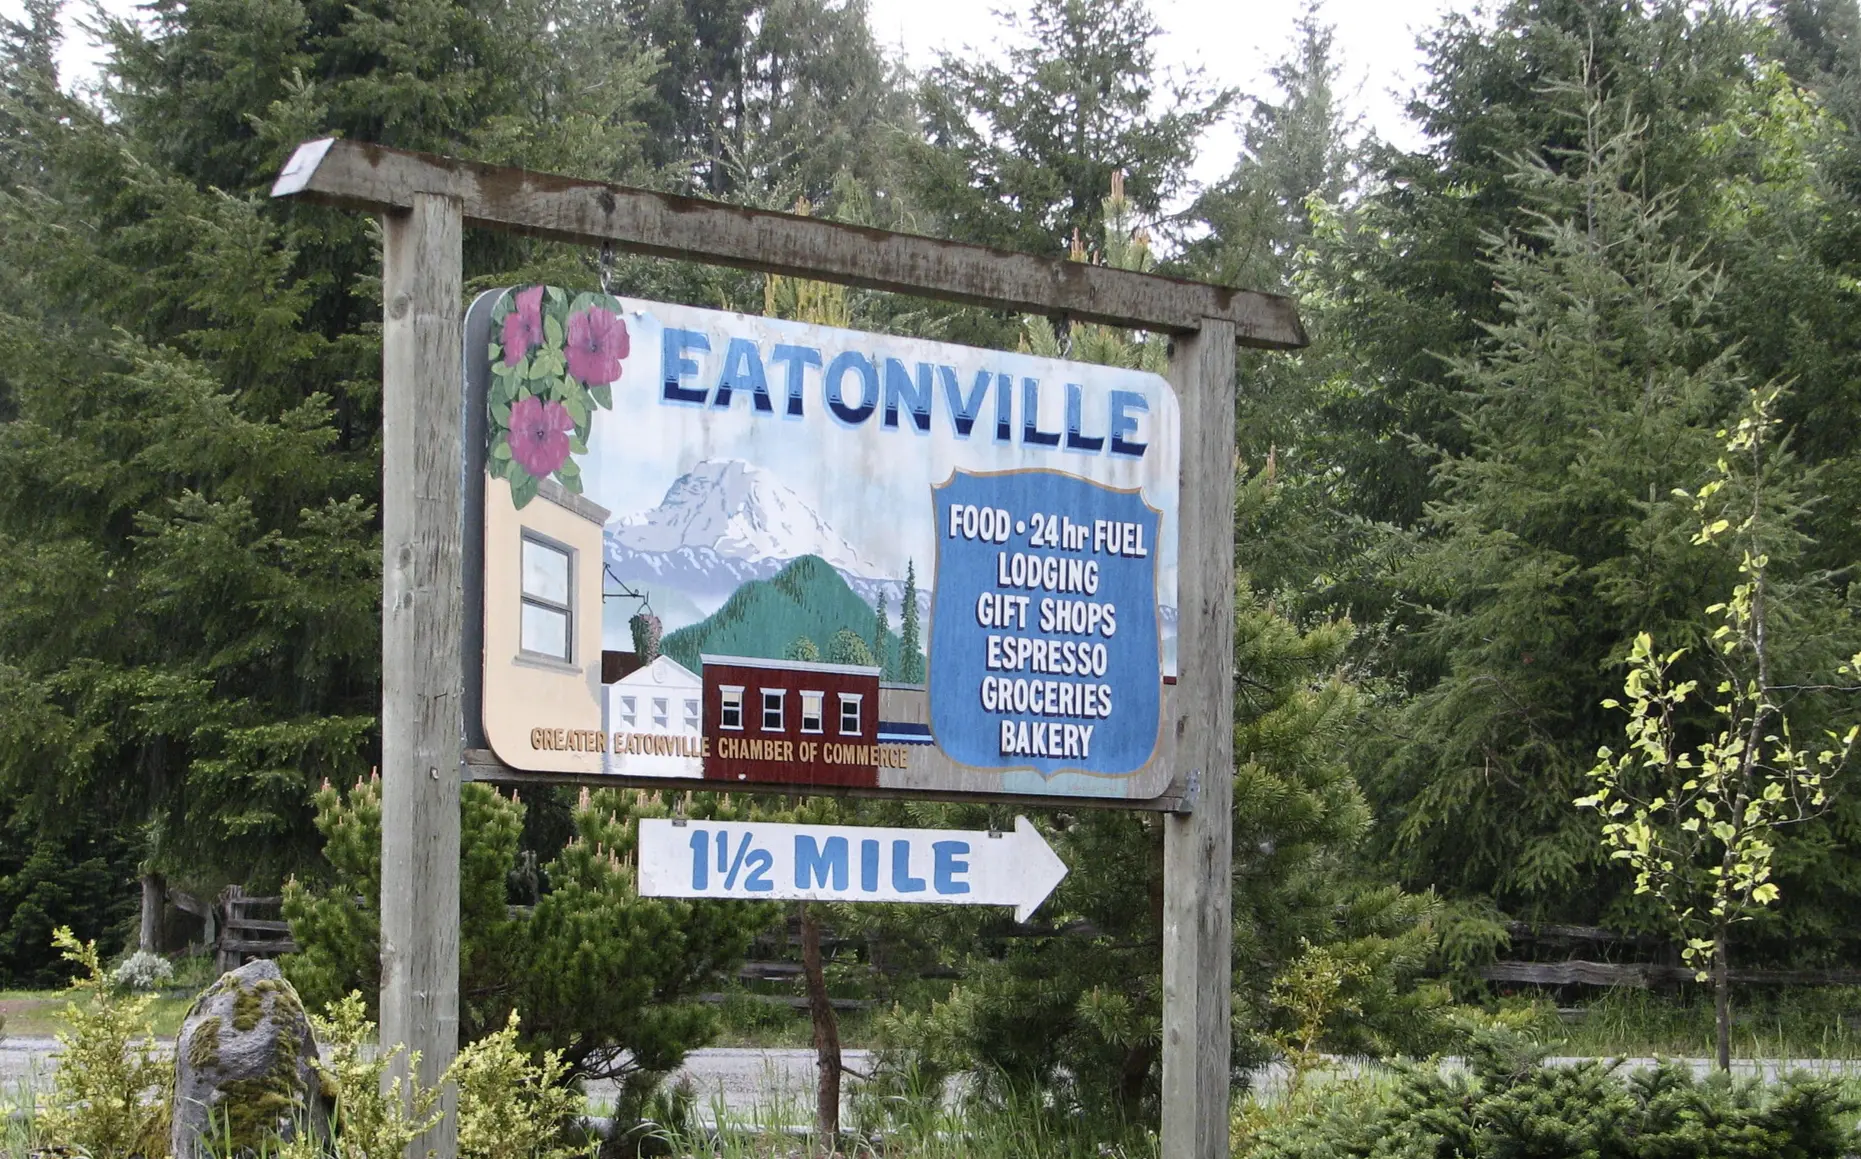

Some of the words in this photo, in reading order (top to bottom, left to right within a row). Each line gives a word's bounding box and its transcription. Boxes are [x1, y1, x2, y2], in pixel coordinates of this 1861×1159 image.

[661, 328, 1150, 457] EATONVILLE
[950, 504, 1010, 542] FOOD
[1094, 519, 1147, 556] FUEL
[998, 552, 1099, 595] LODGING
[976, 592, 1030, 628] GIFT
[1039, 598, 1116, 636] SHOPS
[986, 635, 1107, 676] ESPRESSO
[980, 676, 1112, 718] GROCERIES
[531, 727, 606, 753] GREATER
[614, 732, 710, 759] EATONVILLE
[718, 737, 794, 762] CHAMBER
[799, 741, 818, 763] OF
[823, 743, 908, 769] COMMERCE
[1000, 719, 1093, 759] BAKERY
[794, 834, 971, 895] MILE
